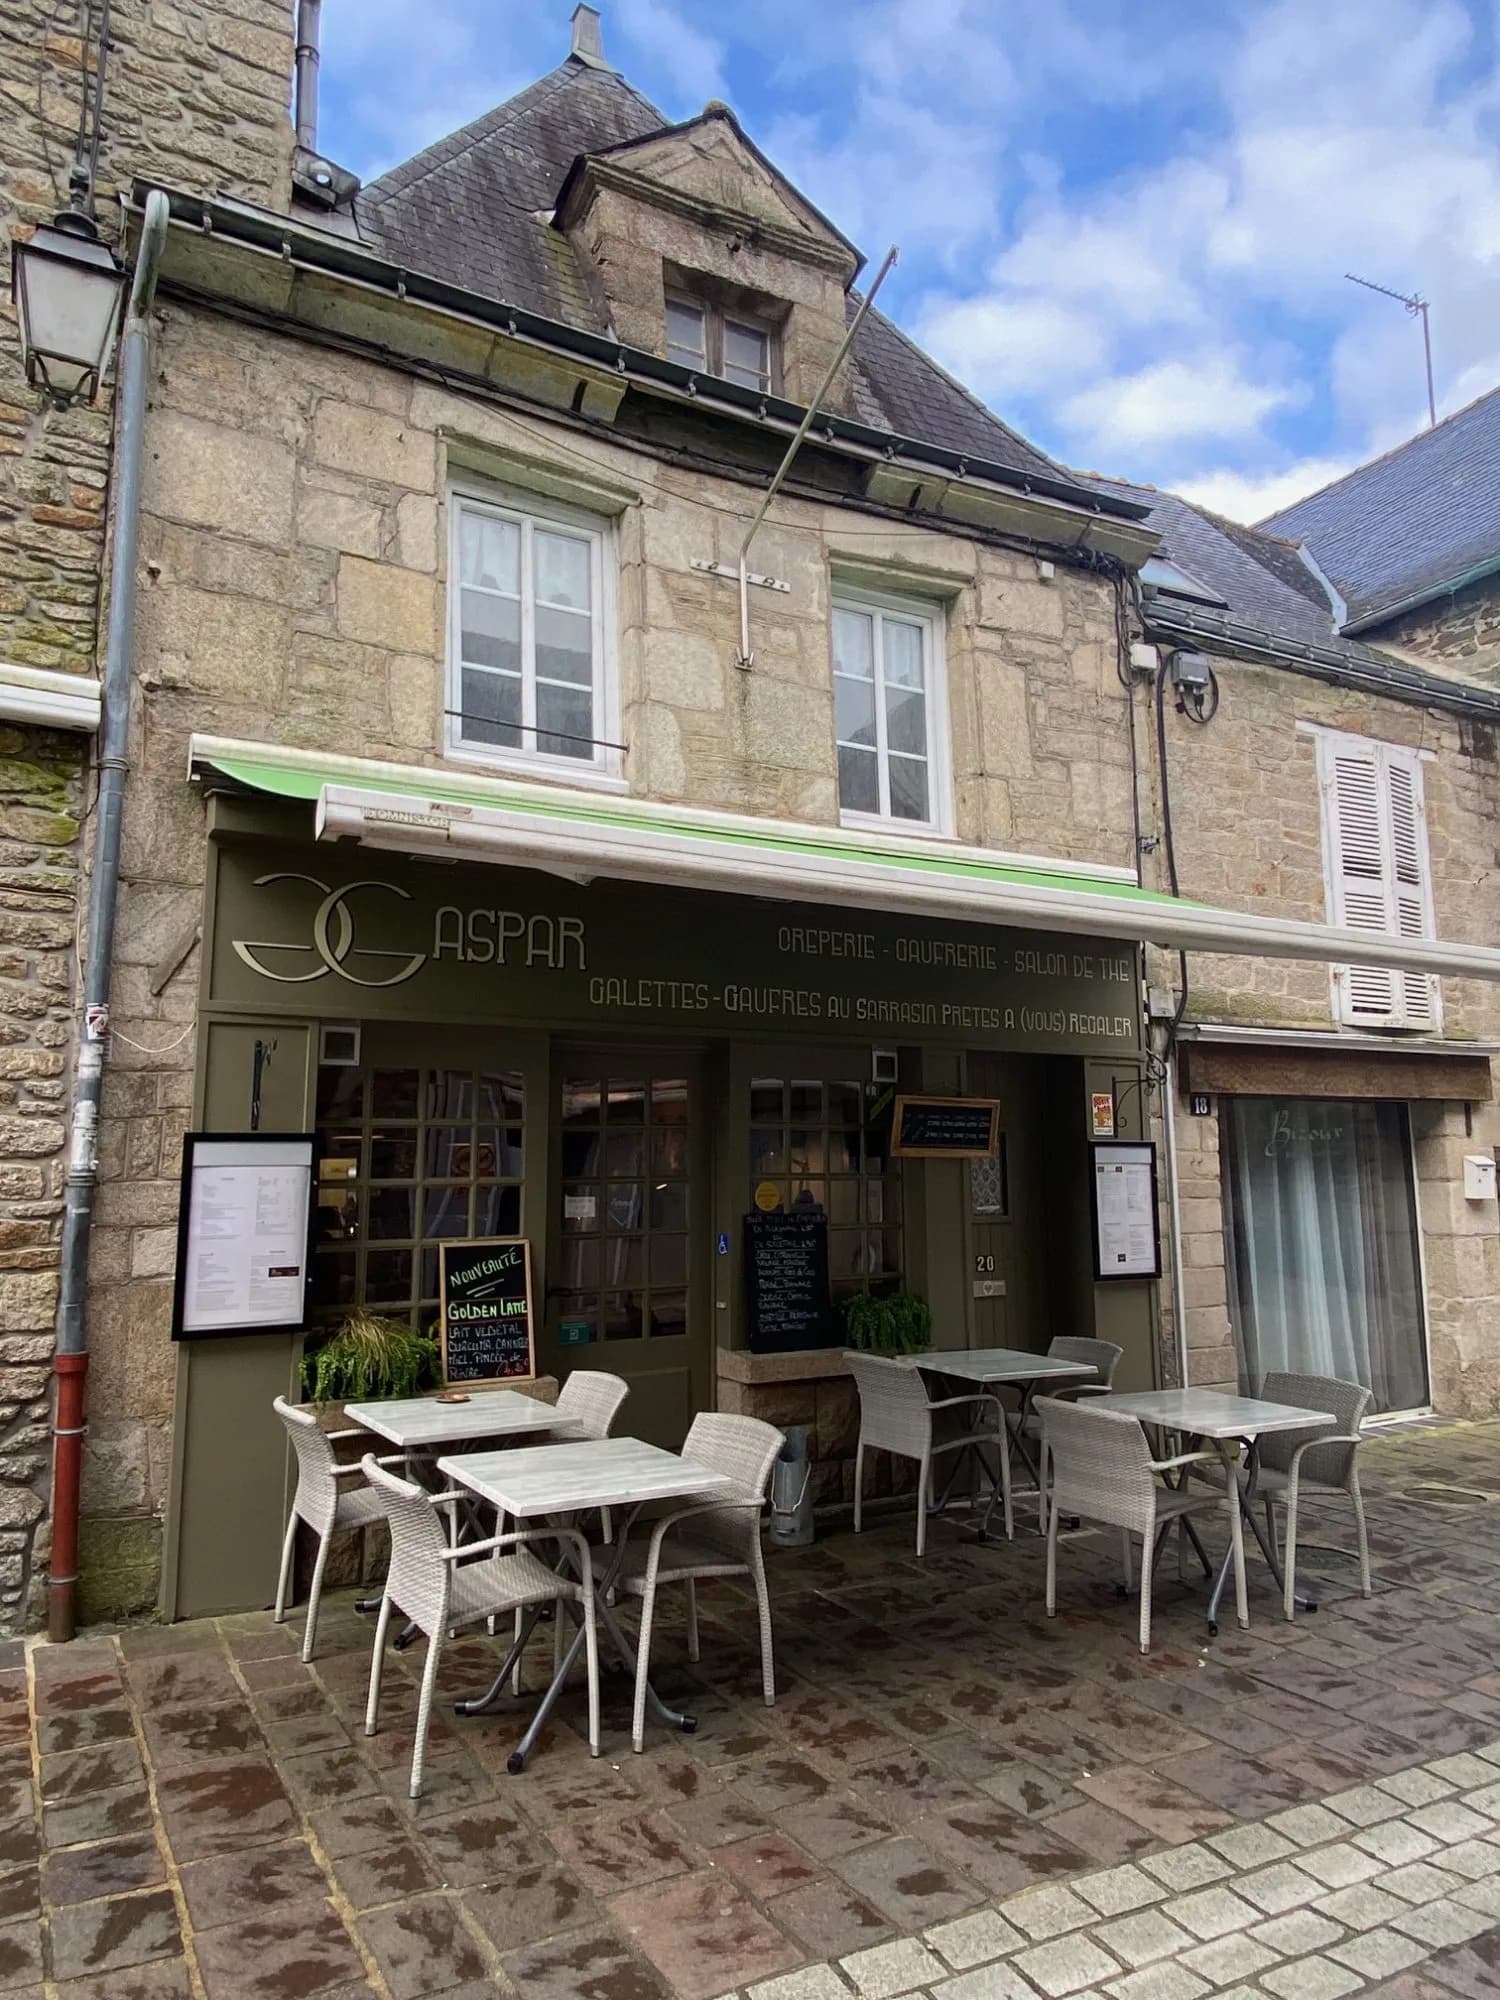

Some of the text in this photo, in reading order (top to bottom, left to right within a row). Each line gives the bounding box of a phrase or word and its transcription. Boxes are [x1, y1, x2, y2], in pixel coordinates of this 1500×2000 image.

[777, 926, 875, 960] CREPERIE
[895, 937, 997, 971] GAUFRERIE
[1014, 949, 1068, 977] SALON
[1073, 954, 1094, 979] DE
[1099, 957, 1130, 982] THE
[827, 995, 850, 1019] AU
[856, 997, 936, 1025] SARRASIN
[941, 1003, 1000, 1029] PRETES
[1005, 1009, 1015, 1029] A
[1020, 1006, 1066, 1035] (VOUS)
[1070, 1012, 1133, 1038] REGALER
[1194, 1096, 1208, 1114] 18
[449, 1246, 523, 1288] NOUVEAUTÉ
[976, 1255, 994, 1273] 20
[448, 1297, 528, 1320] GOLDEN LATTE
